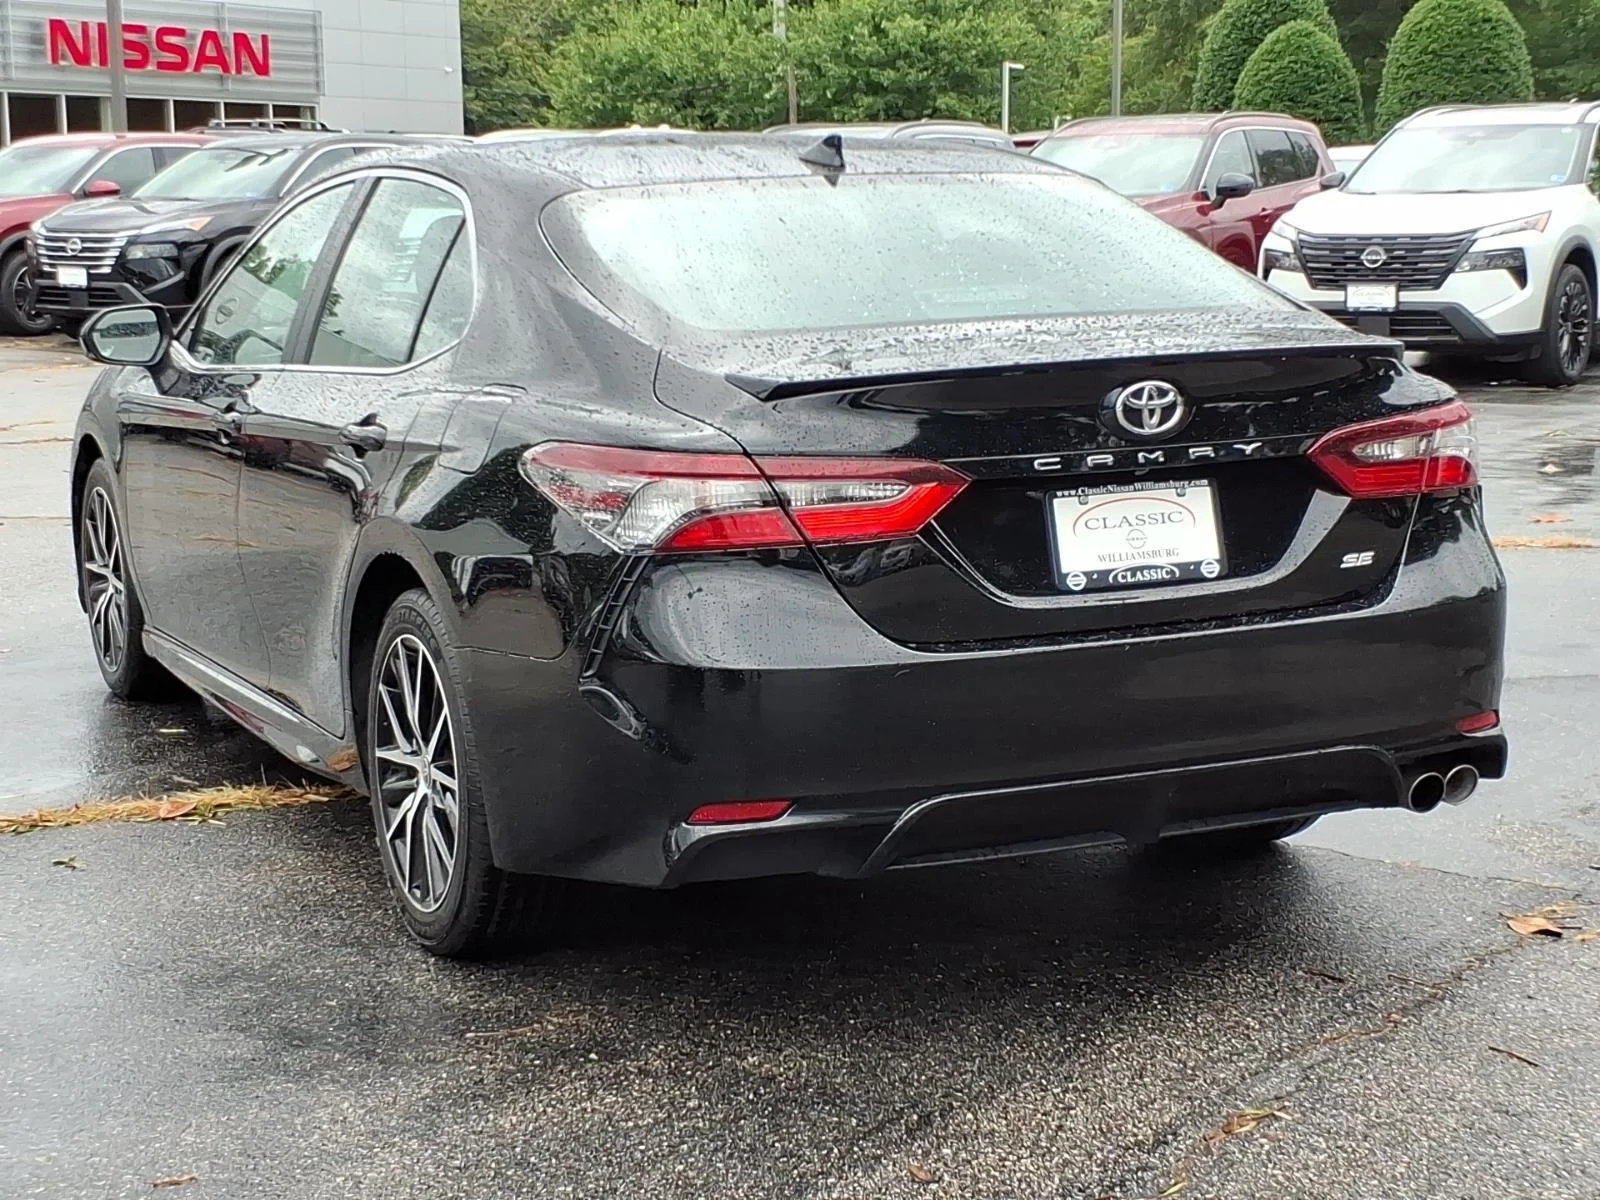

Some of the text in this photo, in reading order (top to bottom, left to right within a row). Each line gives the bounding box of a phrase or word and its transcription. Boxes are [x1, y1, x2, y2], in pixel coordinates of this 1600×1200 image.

[48, 18, 269, 77] NISSAN
[1033, 442, 1263, 471] CAMRY
[1056, 479, 1208, 497] www.ClassicNissanWilliamsburg.com
[1084, 511, 1184, 531] CLASSIC
[1097, 547, 1180, 563] WILLIAMSBURG
[1340, 551, 1375, 569] SE
[1117, 567, 1172, 583] CLASSIC
